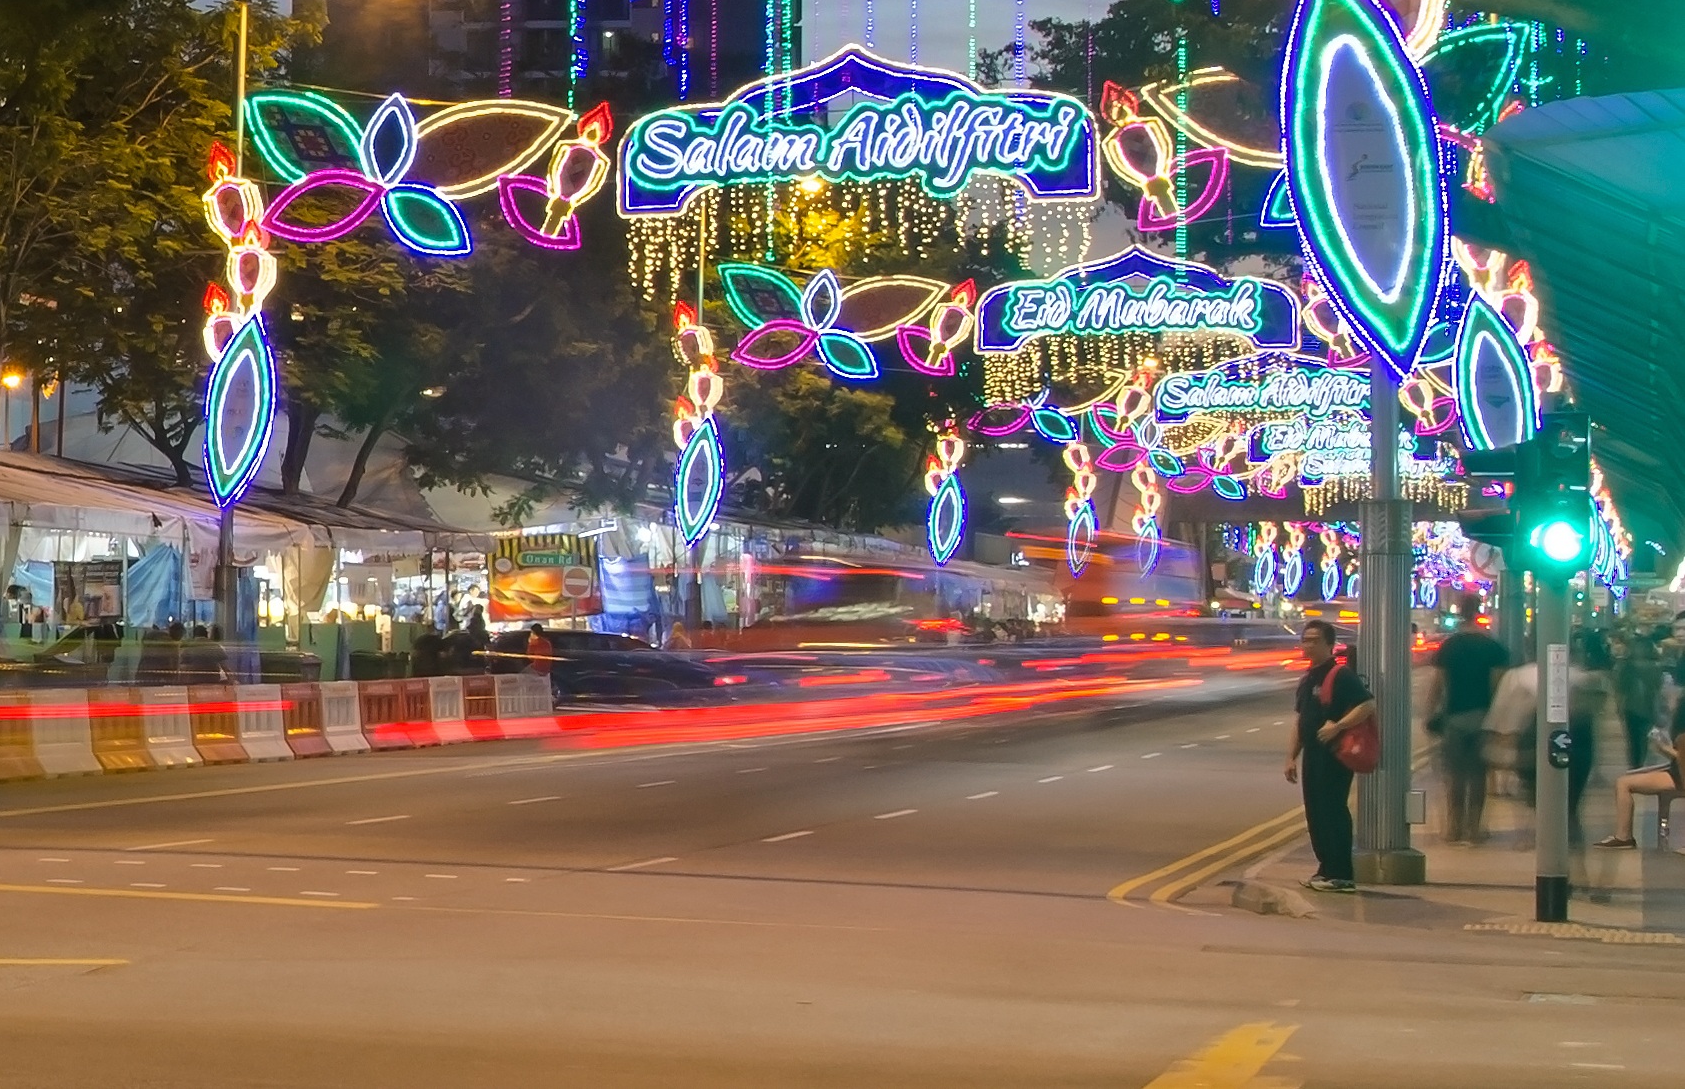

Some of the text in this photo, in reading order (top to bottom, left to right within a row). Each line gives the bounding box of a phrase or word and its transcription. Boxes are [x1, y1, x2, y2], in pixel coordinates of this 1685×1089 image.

[636, 101, 1074, 188] Salam Aidilfitri
[1010, 282, 1257, 330] Eid Mubarak
[1163, 375, 1256, 408] Salam
[526, 554, 573, 565] Onan Rd
